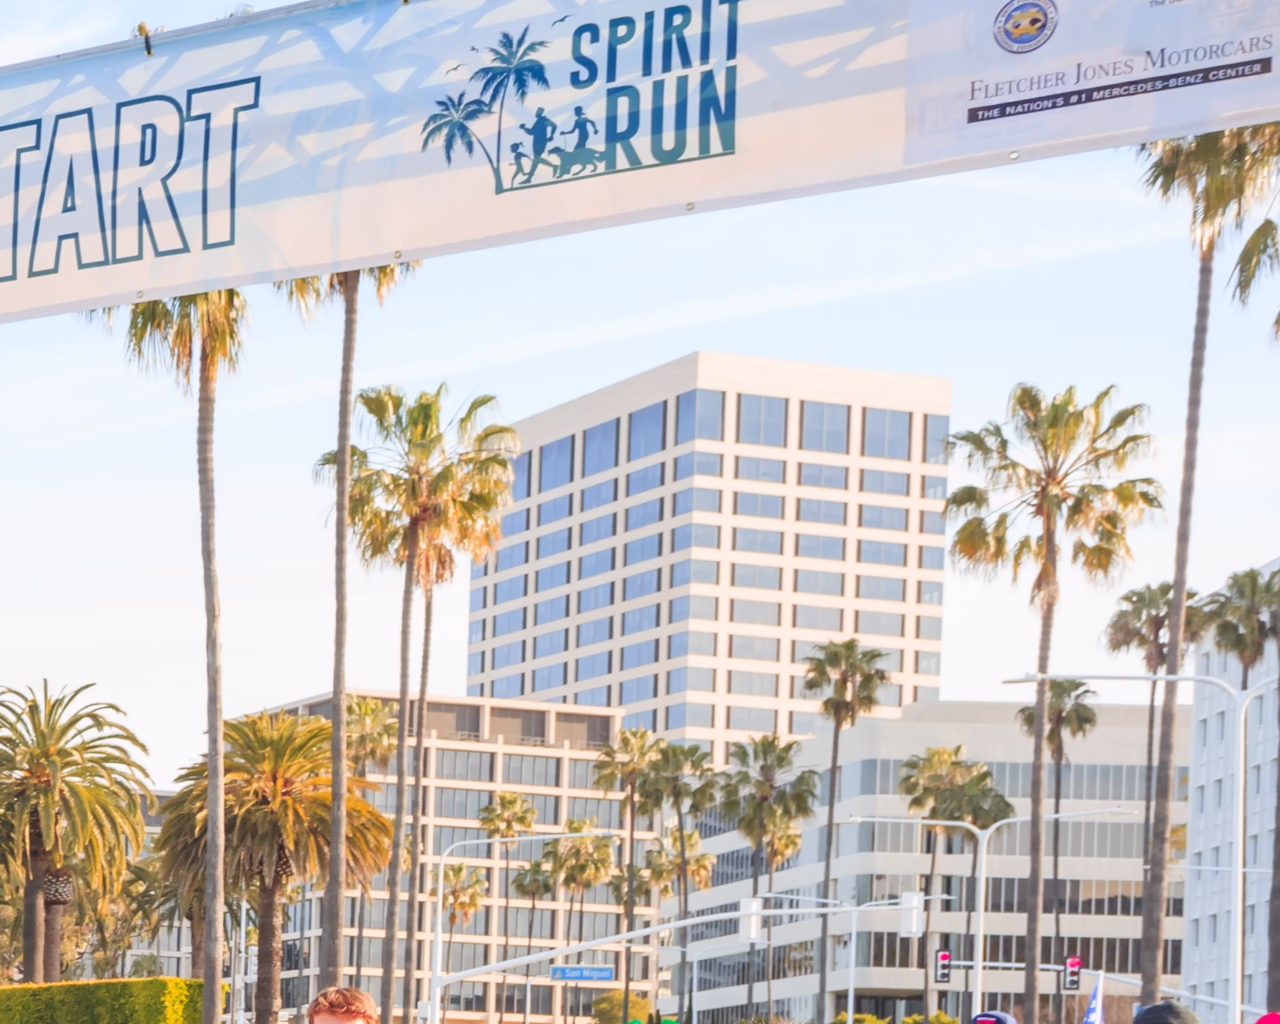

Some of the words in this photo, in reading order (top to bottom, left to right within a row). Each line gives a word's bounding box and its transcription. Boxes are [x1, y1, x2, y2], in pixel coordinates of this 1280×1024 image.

[570, 0, 743, 90] SPIRIT
[969, 72, 1066, 101] FLETCHER
[1074, 59, 1134, 85] JONES
[1143, 33, 1273, 71] MOTORCARS
[605, 65, 738, 170] RUN
[976, 108, 1001, 120] THE
[1005, 97, 1064, 115] NATION'S
[1092, 73, 1204, 101] MERCEDES-BENZ
[1208, 63, 1262, 81] CENTER
[565, 968, 581, 977] San
[583, 968, 611, 980] Miguel
